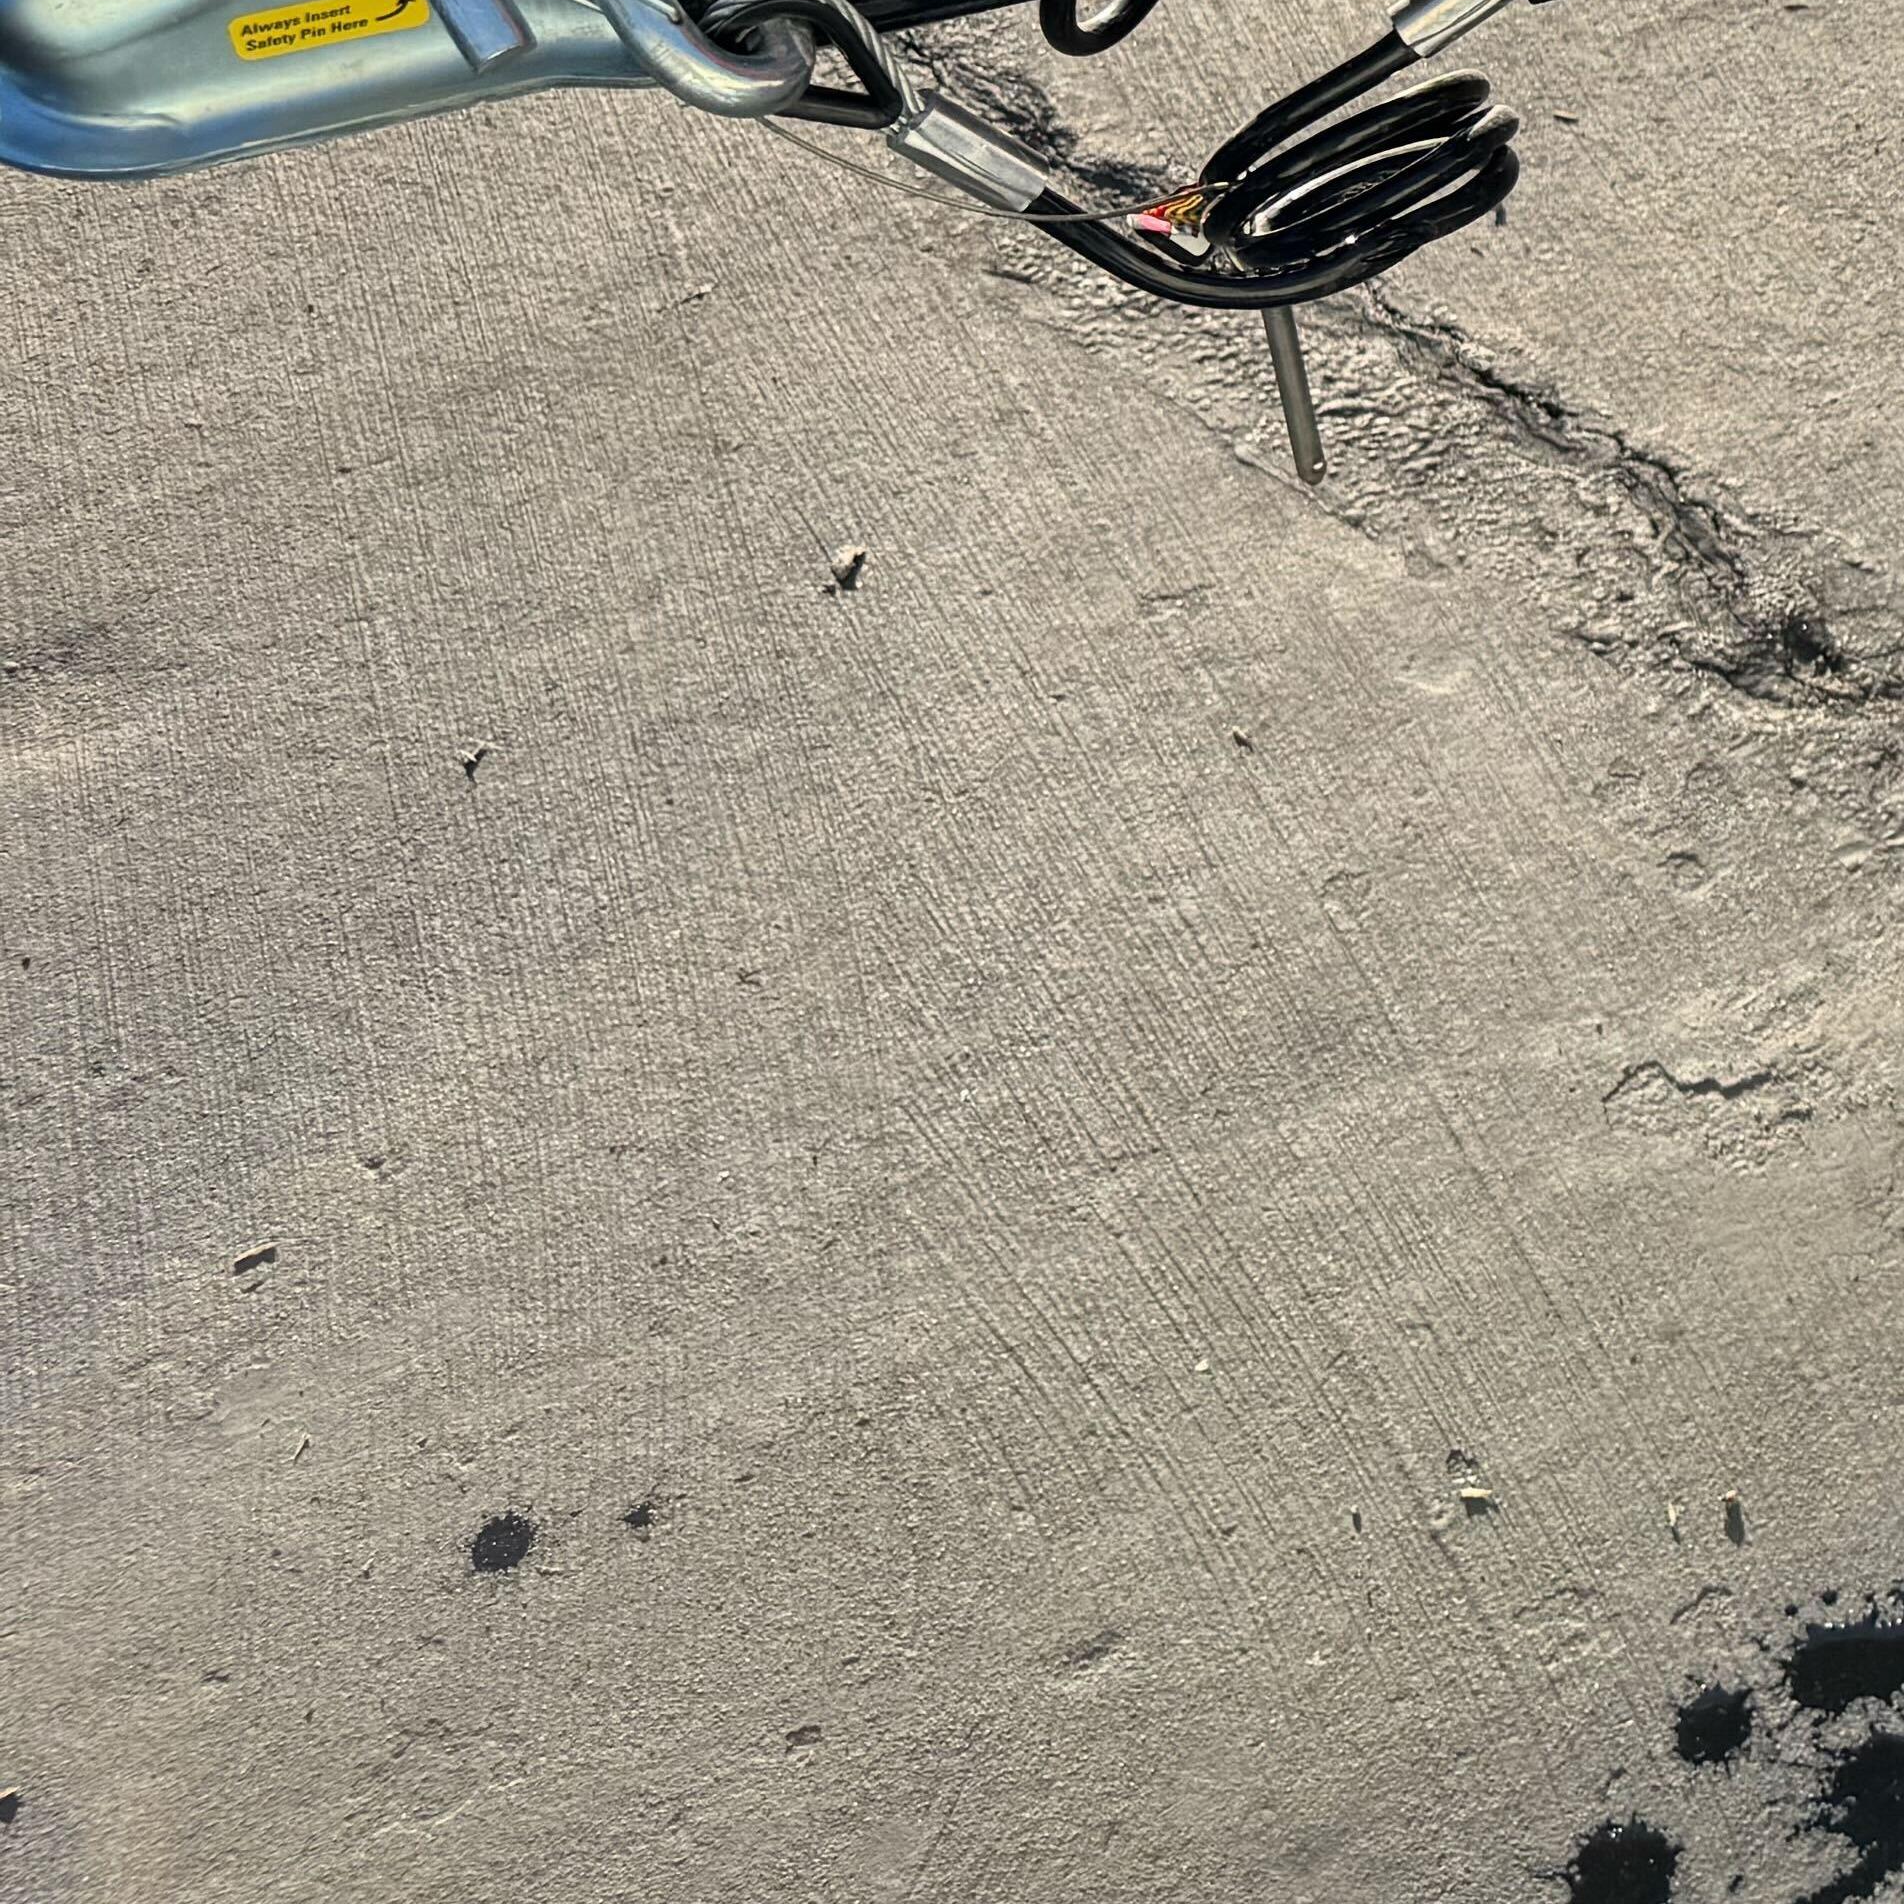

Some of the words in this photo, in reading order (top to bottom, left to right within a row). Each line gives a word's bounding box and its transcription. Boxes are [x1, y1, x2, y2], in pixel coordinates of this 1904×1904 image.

[241, 15, 301, 36] Always
[305, 4, 352, 23] Insert
[246, 33, 296, 51] Safety
[301, 27, 326, 40] Pin
[331, 17, 368, 33] Here
